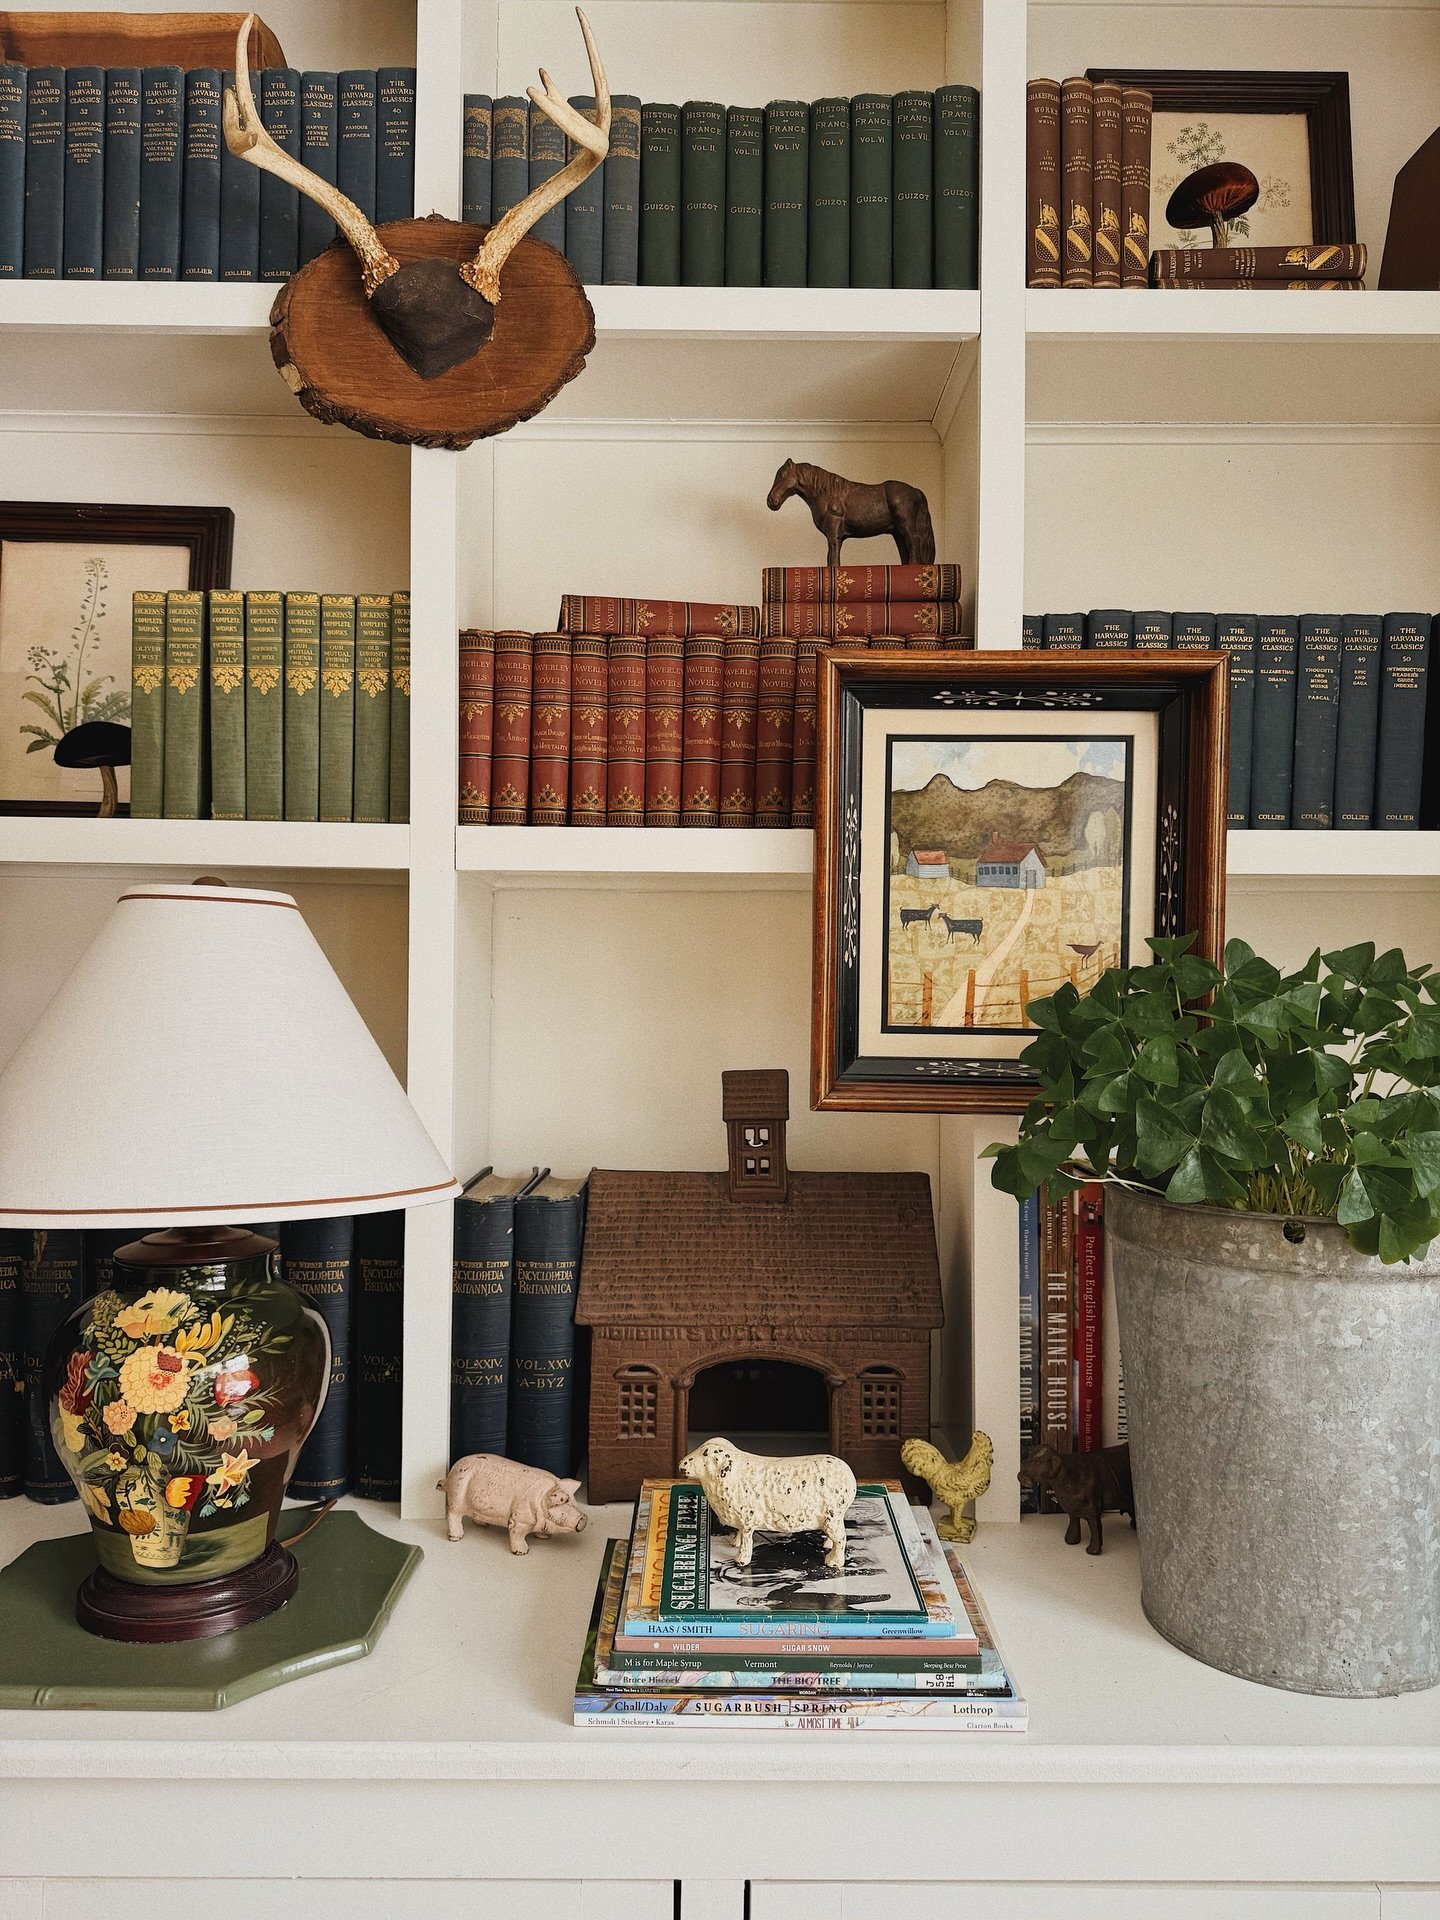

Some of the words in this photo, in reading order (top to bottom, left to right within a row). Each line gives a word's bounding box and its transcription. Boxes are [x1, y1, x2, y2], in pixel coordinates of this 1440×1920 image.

[69, 88, 101, 96] HARVARD
[146, 97, 176, 105] CLASSICS
[898, 100, 932, 109] HISTORY
[856, 103, 891, 111] HISTORY
[1034, 106, 1058, 115] WORKS
[1066, 106, 1090, 114] WORKS
[642, 112, 677, 120] HISTORY
[686, 112, 720, 120] HISTORY
[769, 110, 805, 118] HISTORY
[856, 118, 891, 127] FRANCE
[642, 127, 678, 136] FRANCE
[686, 127, 721, 135] FRANCE
[769, 125, 805, 134] FRANCE
[857, 195, 888, 204] GUIZOT
[898, 193, 929, 201] GUIZOT
[644, 203, 675, 212] GUIZOT
[687, 203, 718, 211] GUIZOT
[770, 202, 802, 210] GUIZOT
[650, 679, 681, 687] NOVELS
[688, 679, 720, 687] NOVELS
[1258, 813, 1286, 821] COLLIER
[1086, 1236, 1096, 1275] Perfect
[519, 1280, 572, 1294] BRITANNICA
[1048, 1271, 1067, 1302] THE
[1083, 1279, 1096, 1322] English
[1020, 1294, 1032, 1320] THE
[1048, 1312, 1067, 1366] MAINE
[1020, 1326, 1032, 1371] MAINE
[1085, 1325, 1096, 1388] Farmhouse
[1020, 1377, 1032, 1422] HOUSE
[1047, 1377, 1067, 1431] HOUSE
[670, 1534, 698, 1610] SUGARING
[648, 1625, 674, 1633] HAAS
[682, 1626, 713, 1634] SMITH
[739, 1622, 830, 1636] SUGARING
[672, 1643, 700, 1651] WILDER
[656, 1659, 678, 1669] Maple
[680, 1659, 702, 1669] Syrup
[745, 1660, 777, 1668] Vermont
[623, 1676, 646, 1684] Bruce
[648, 1676, 680, 1684] Hiscock
[771, 1677, 792, 1685] THE
[795, 1677, 812, 1685] BIG
[817, 1677, 841, 1685] TREE
[615, 1702, 668, 1713] Chall/Daly
[695, 1703, 782, 1713] SUGARBUSH
[794, 1704, 847, 1713] SPRING
[953, 1705, 993, 1716] Lothrop
[621, 1718, 649, 1726] Stickney
[798, 1718, 825, 1729] ALMOST
[828, 1718, 843, 1729] TIME
